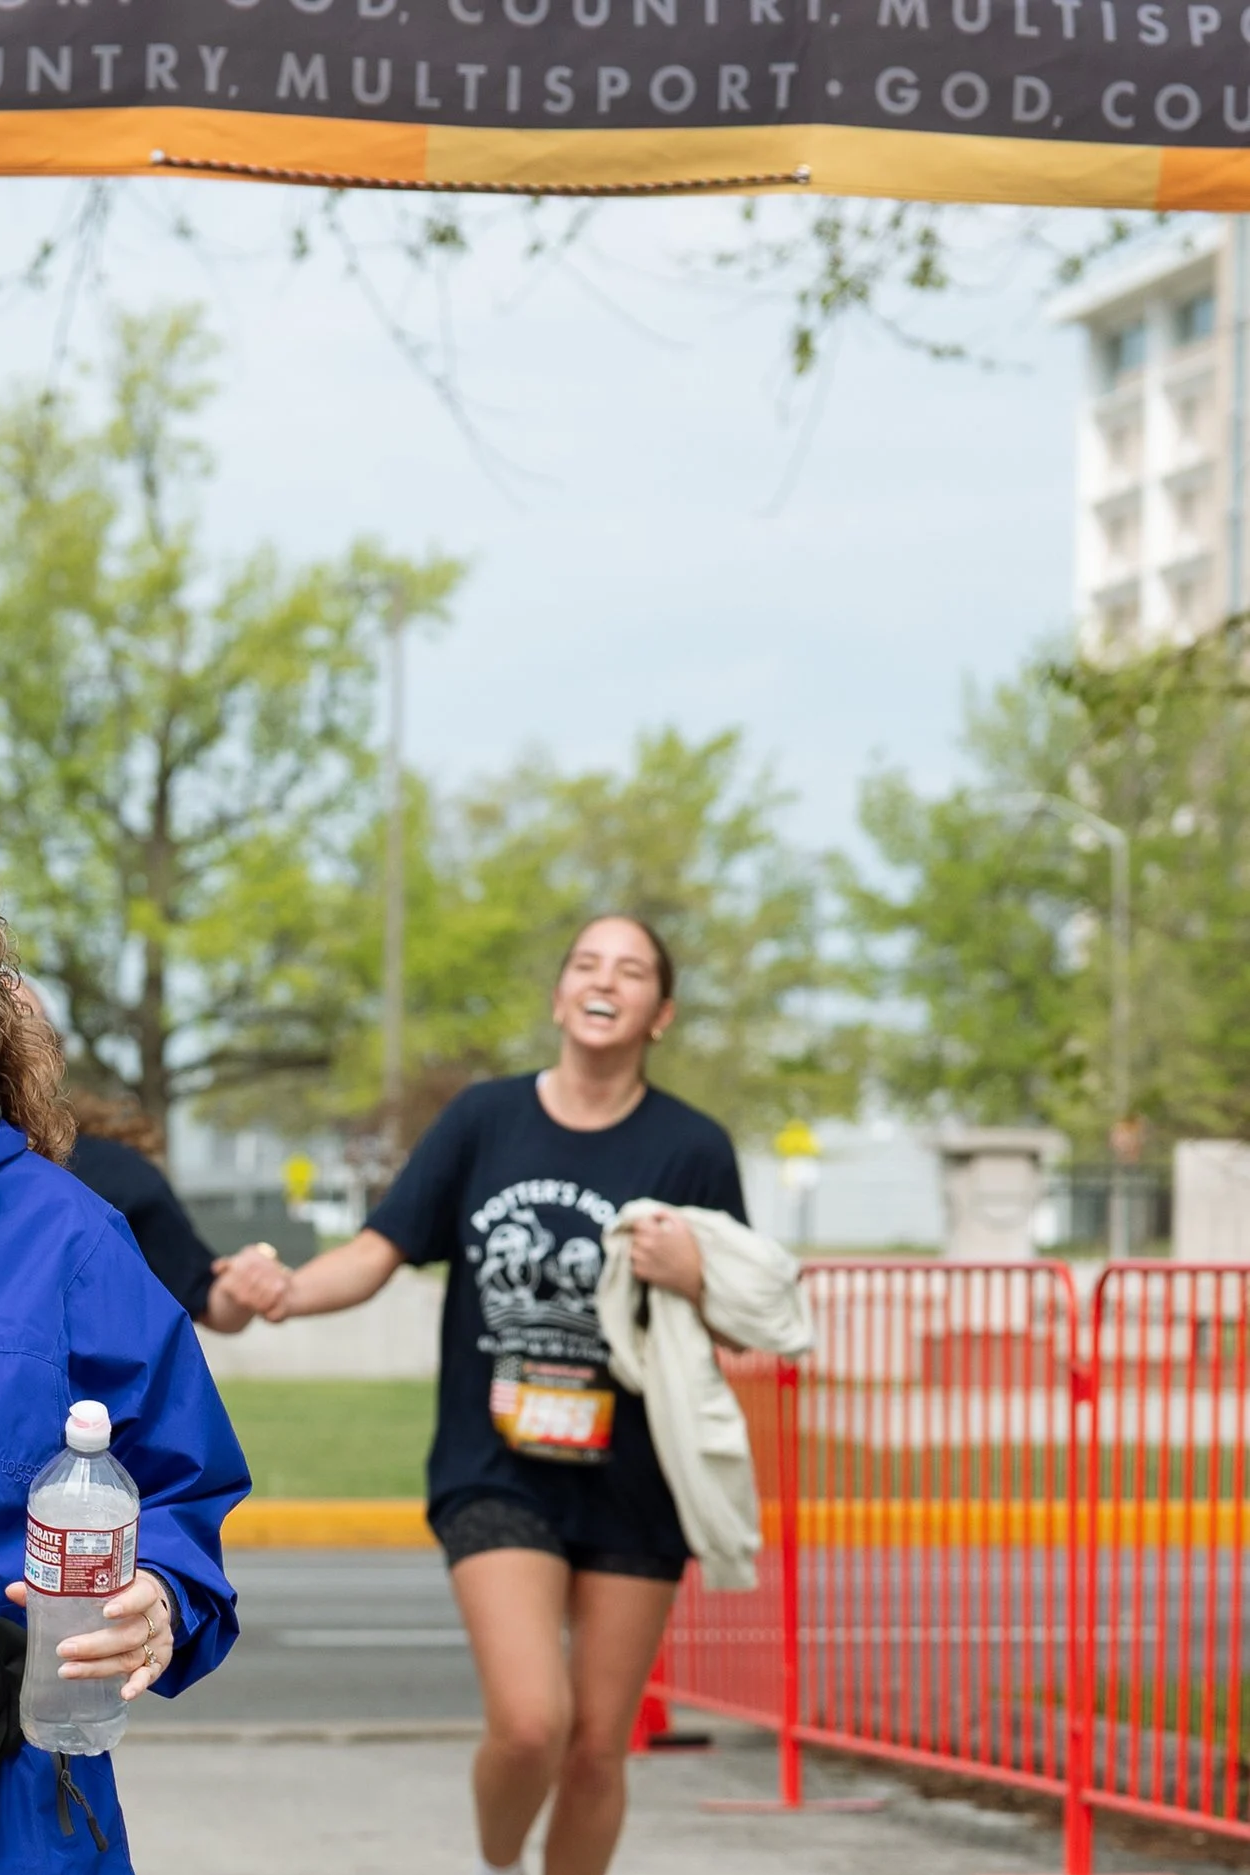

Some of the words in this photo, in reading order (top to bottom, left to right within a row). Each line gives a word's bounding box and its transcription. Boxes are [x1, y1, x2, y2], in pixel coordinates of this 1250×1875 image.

[876, 0, 1250, 48] MULTISP
[276, 51, 797, 114] MULTISPORT
[874, 66, 1062, 127] GOD,
[1101, 80, 1250, 132] COU
